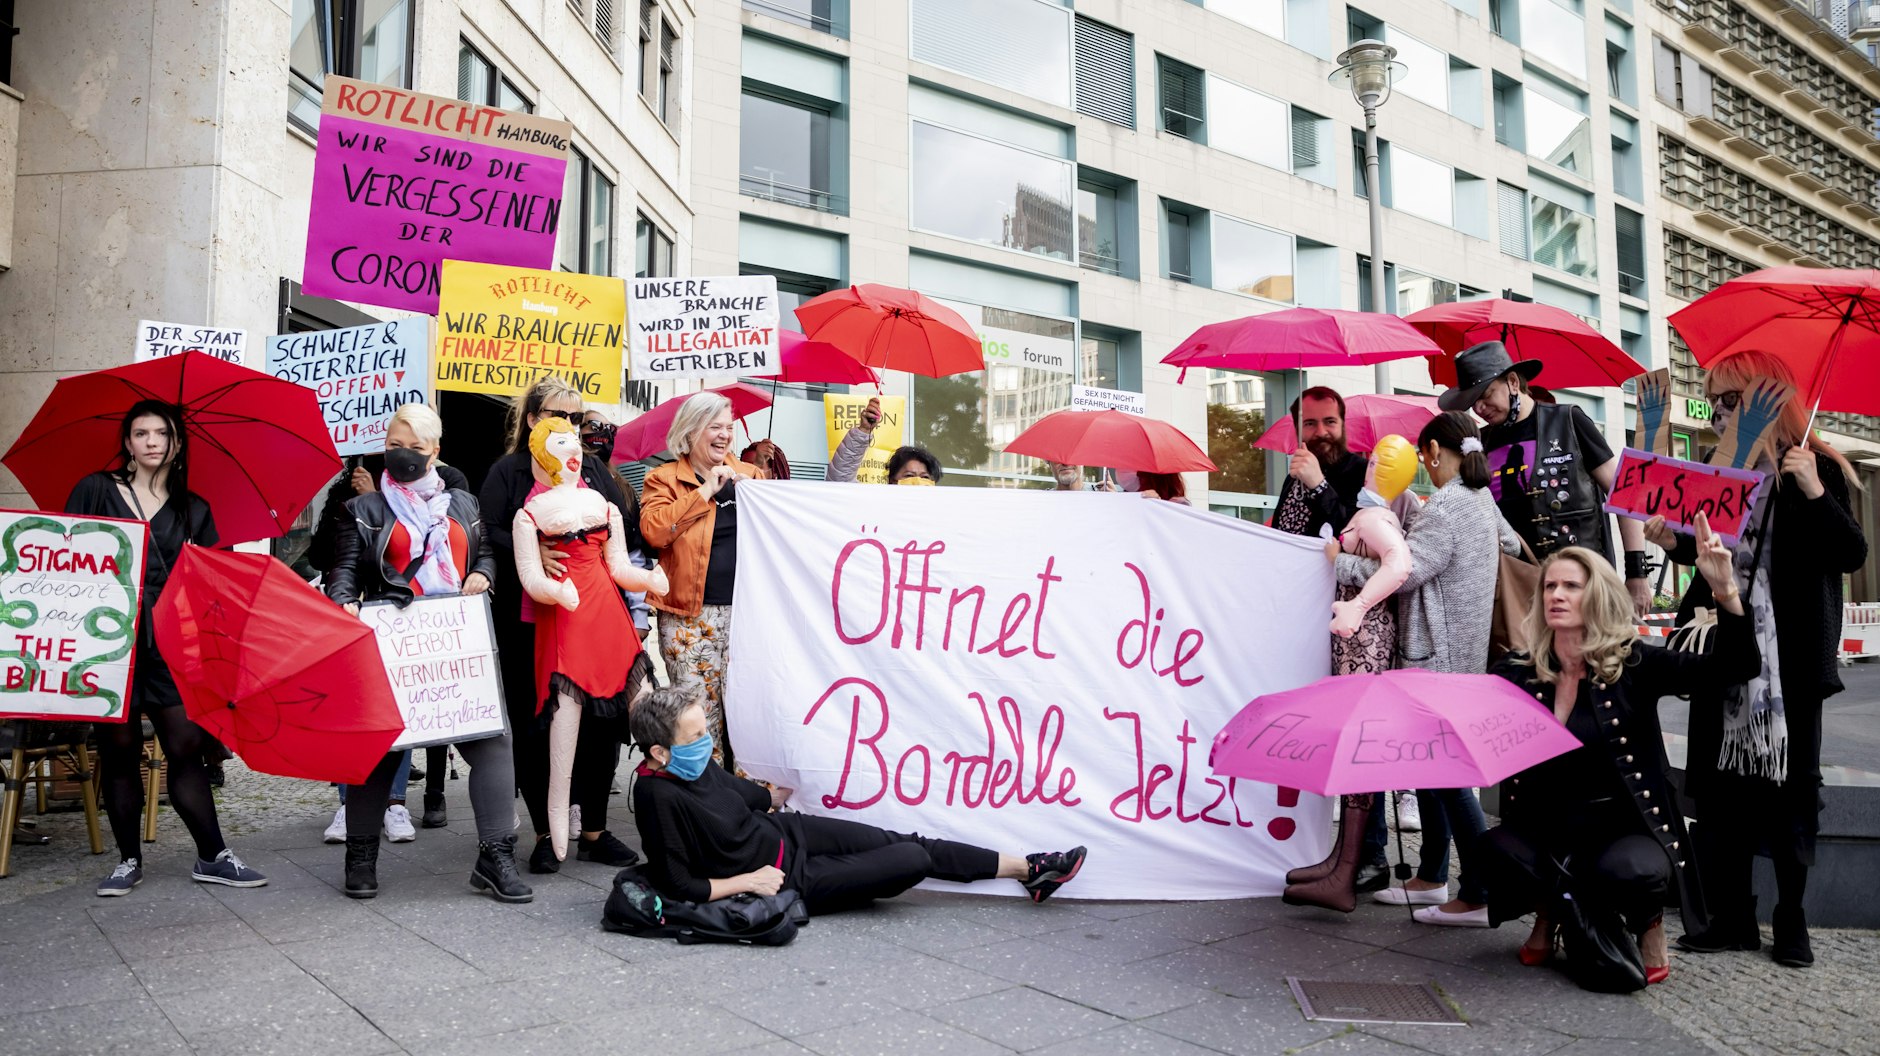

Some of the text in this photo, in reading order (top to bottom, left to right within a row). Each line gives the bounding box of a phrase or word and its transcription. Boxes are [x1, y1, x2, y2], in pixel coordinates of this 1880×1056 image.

[337, 84, 567, 152] ROTLICHT HAMBURG
[337, 131, 531, 183] WIR SIND DIE
[342, 163, 562, 236] VERGESSENEN
[397, 222, 453, 246] DER
[331, 246, 441, 297] CORON
[635, 280, 711, 300] UNSERE
[678, 296, 768, 315] BRANCHE
[145, 326, 242, 346] DER STAAT
[445, 311, 621, 348] WIR BRAUCHEN
[638, 314, 751, 333] WIRD IN DIE
[647, 326, 774, 353] ILLEGALITÄT
[272, 321, 399, 362] SCHWEIZ &
[441, 336, 584, 369] FINANZIELLE
[979, 333, 1063, 367] ios forum
[274, 348, 406, 384] ÖSTERREICH
[650, 350, 766, 372] GETRIEBEN
[319, 389, 424, 424] TSCHLAND
[1085, 389, 1135, 403] SEX IST NICHT
[1130, 405, 1144, 415] ALS
[1687, 398, 1713, 421] DEU
[360, 417, 390, 439] FREC
[834, 420, 861, 431] LIGH
[1614, 460, 1653, 492] LET
[1646, 473, 1685, 515] US
[1681, 482, 1759, 527] WORK
[17, 544, 121, 576] STIGMA
[39, 607, 87, 631] pay
[831, 525, 1205, 687] Öffnet die
[15, 634, 77, 662] THE
[391, 629, 464, 657] VERBOT
[6, 665, 99, 696] BILLS
[389, 655, 487, 688] VERNICHTET
[408, 683, 462, 704] unsere
[404, 697, 499, 735] beitsplätze
[803, 676, 1081, 810] Bordelle
[1247, 711, 1328, 762] Fleur
[1351, 719, 1459, 764] Escort
